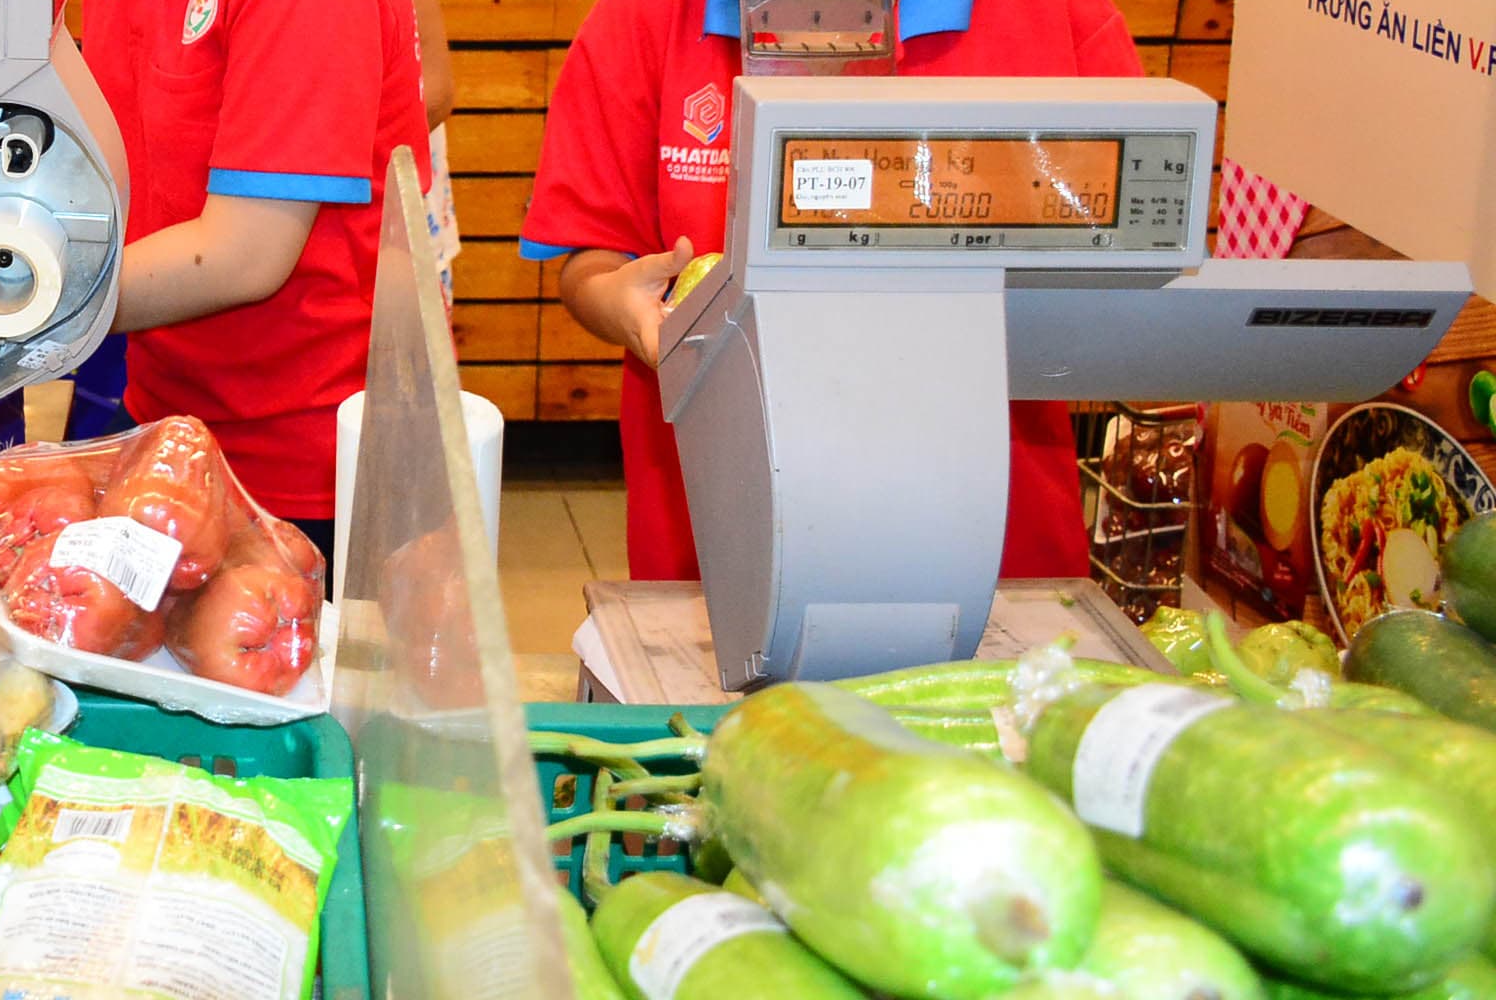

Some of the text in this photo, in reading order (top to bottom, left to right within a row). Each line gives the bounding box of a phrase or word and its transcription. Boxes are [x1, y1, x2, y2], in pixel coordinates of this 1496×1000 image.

[1377, 0, 1406, 44] ĂN
[1412, 19, 1462, 64] LIỀN
[1164, 159, 1185, 175] kg
[796, 176, 866, 191] PT-19-07
[849, 231, 870, 246] kg
[965, 234, 992, 247] per
[1249, 309, 1432, 327] BIZERBA
